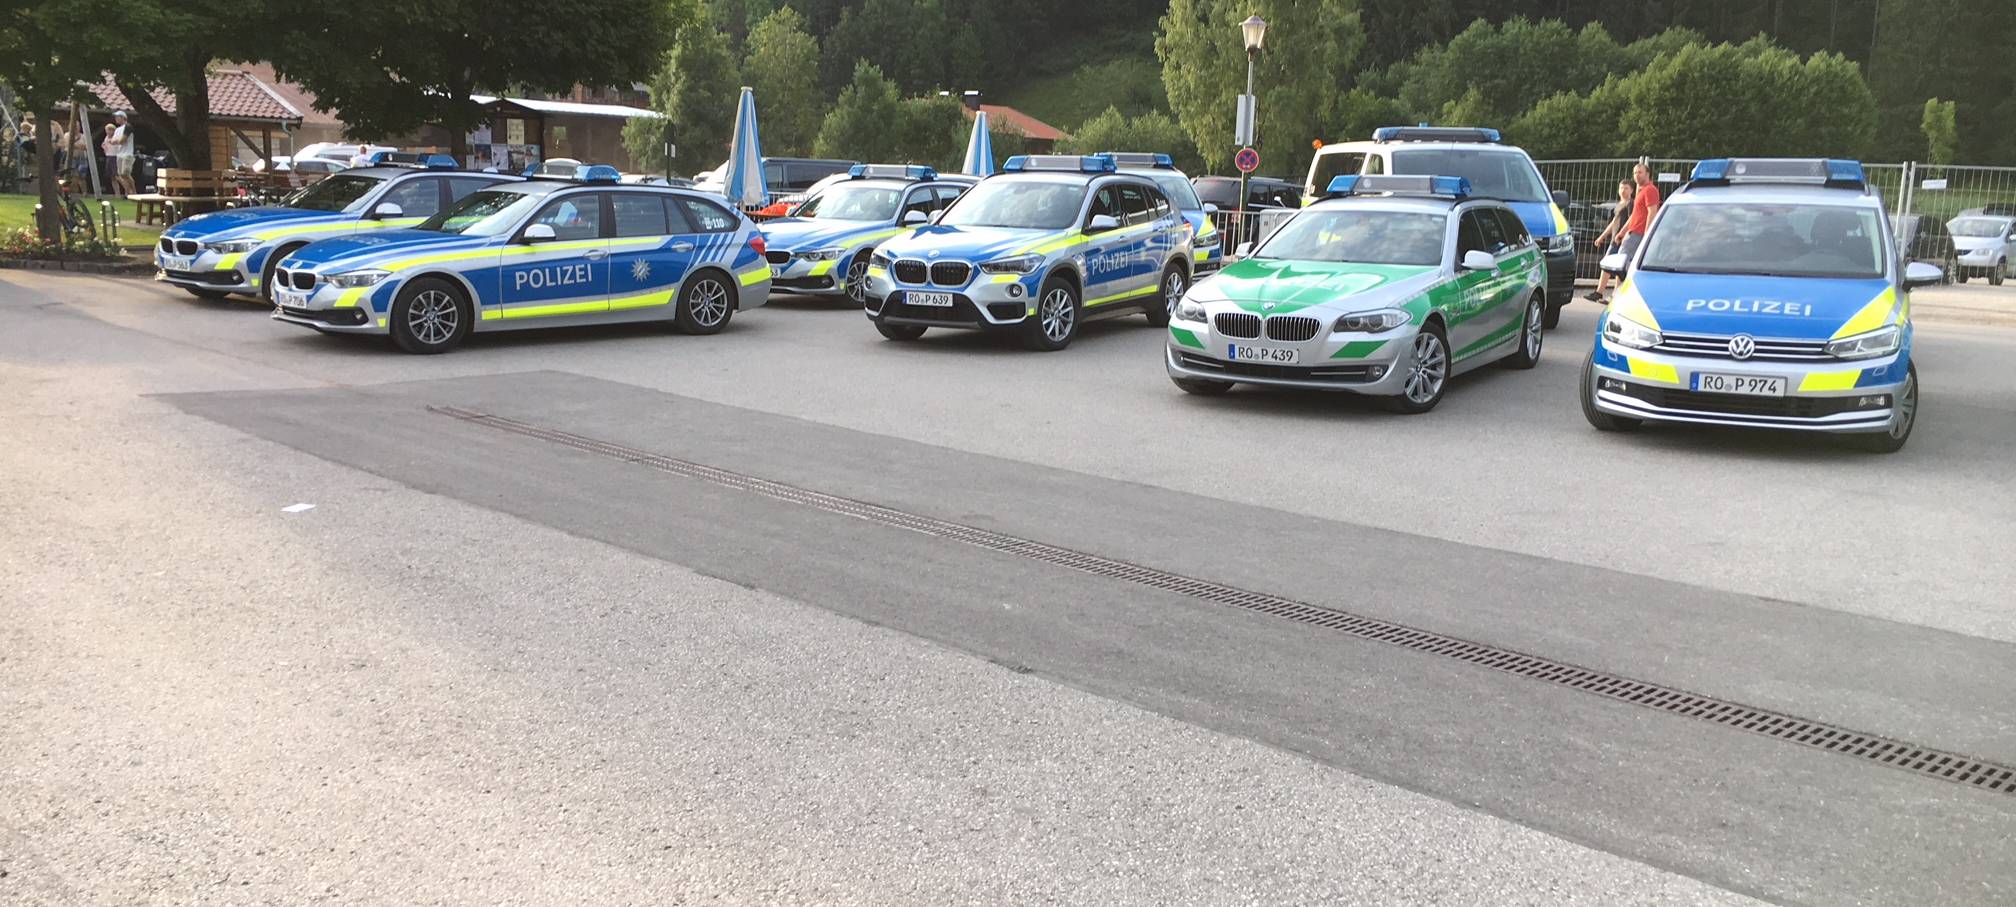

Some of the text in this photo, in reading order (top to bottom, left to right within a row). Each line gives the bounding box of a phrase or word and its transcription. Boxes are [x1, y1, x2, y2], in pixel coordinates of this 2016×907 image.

[1090, 251, 1128, 276] POLIZEI
[515, 263, 592, 290] POLIZEI
[908, 293, 949, 305] RO P 639
[1686, 298, 1812, 317] POLIZEI
[1238, 346, 1293, 361] RO P 439
[1704, 375, 1777, 394] RO P 974
